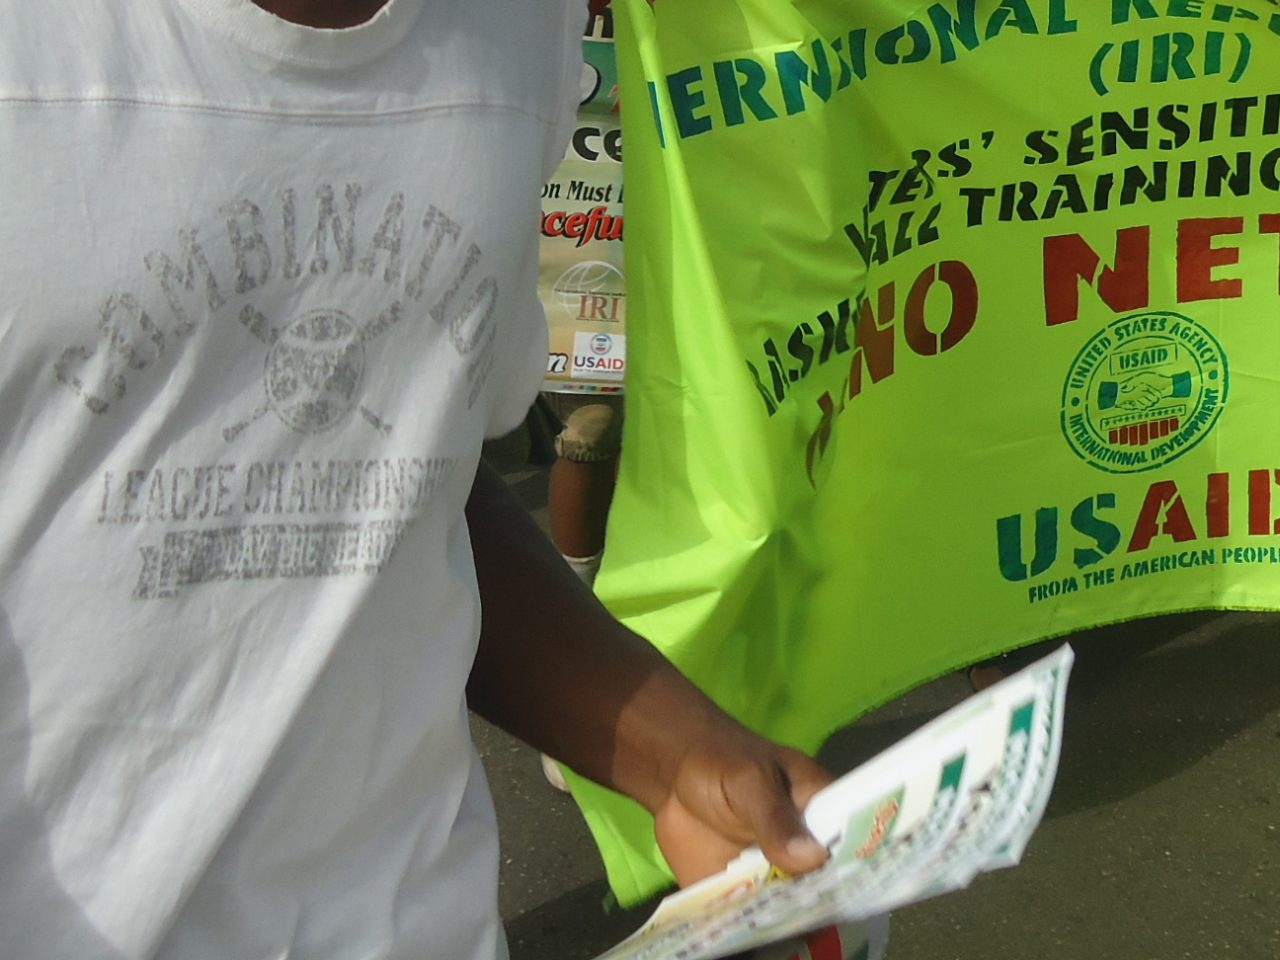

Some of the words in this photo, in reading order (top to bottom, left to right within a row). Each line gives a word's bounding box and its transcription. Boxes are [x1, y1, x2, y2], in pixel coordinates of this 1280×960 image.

[1088, 30, 1253, 96] (IRI)
[566, 180, 614, 203] Must
[578, 295, 621, 321] IRI
[573, 355, 625, 371] USAID
[1069, 335, 1112, 390] UNITED
[1114, 317, 1168, 341] STATES
[1168, 321, 1219, 366] AGENCY
[1119, 347, 1169, 371] USAID
[97, 462, 237, 525] LEAGUE
[1028, 576, 1079, 604] FROM
[1083, 568, 1115, 588] THE
[1120, 548, 1216, 581] AMERICAN
